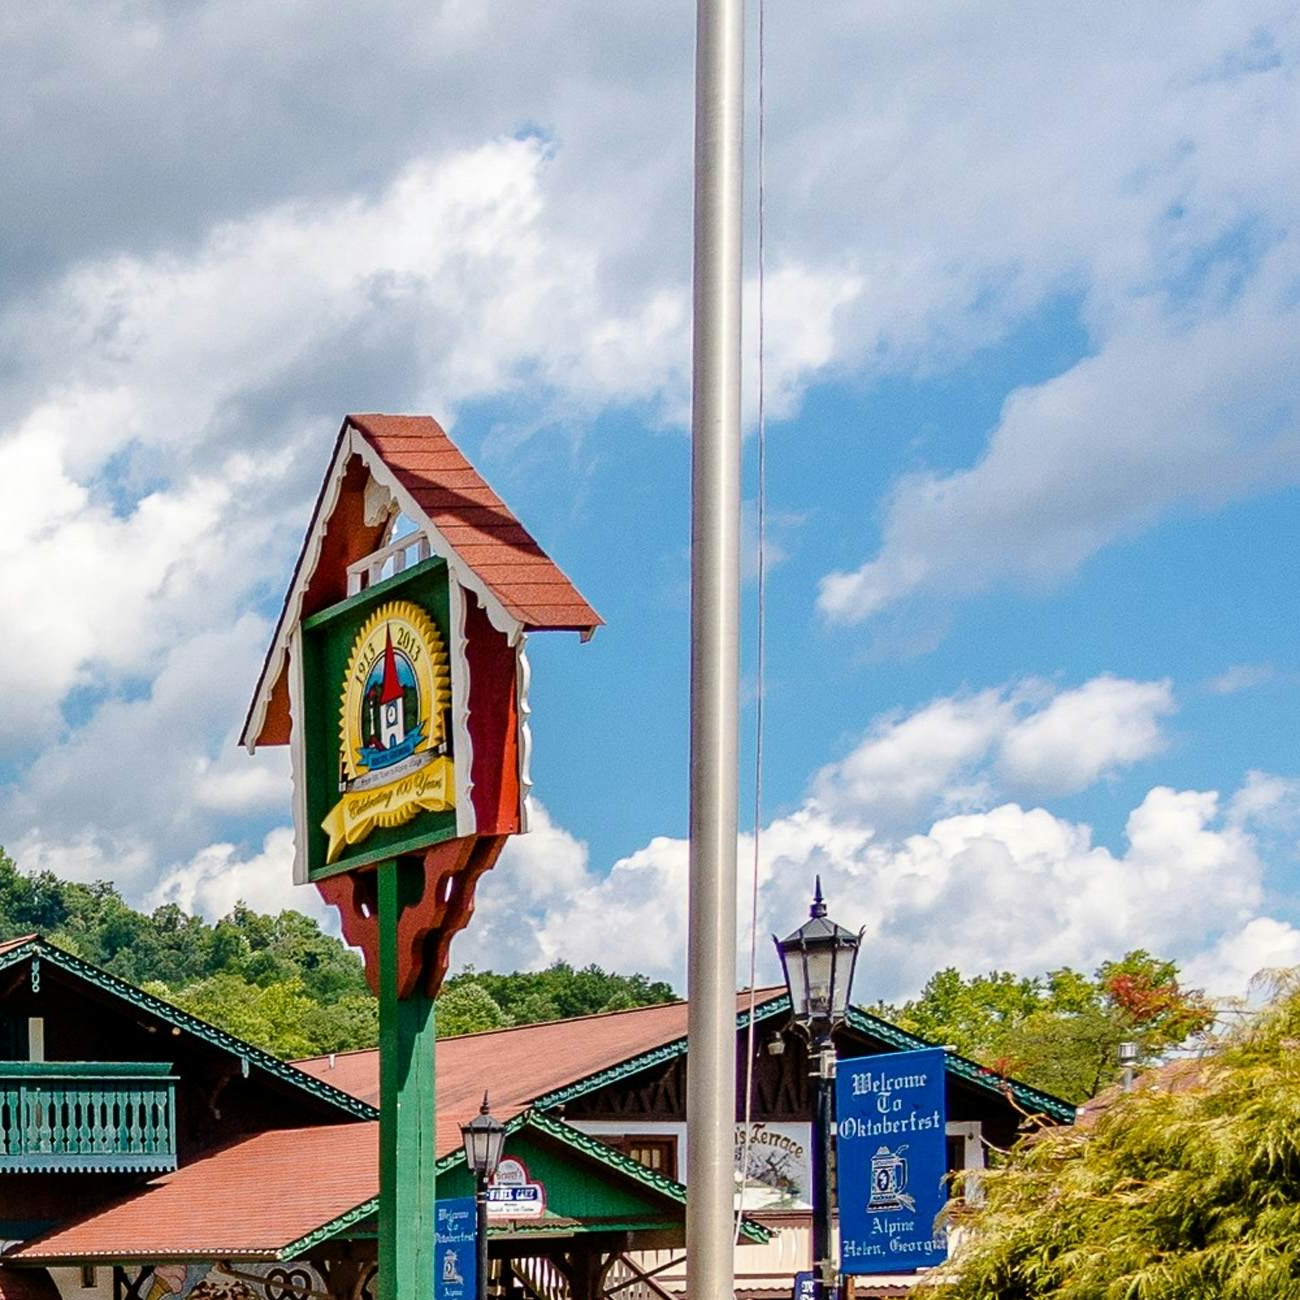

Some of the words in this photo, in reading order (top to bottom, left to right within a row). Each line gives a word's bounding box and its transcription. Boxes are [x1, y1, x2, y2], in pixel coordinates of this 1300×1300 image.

[355, 642, 376, 686] 1913
[397, 627, 421, 662] 2013
[852, 1072, 927, 1096] Welcome
[876, 1092, 902, 1114] To
[838, 1110, 941, 1140] Oktoberfest
[750, 1122, 804, 1159] Terrace
[438, 1208, 469, 1222] Welcome
[871, 1217, 915, 1237] Alpine
[843, 1240, 886, 1258] Helen,
